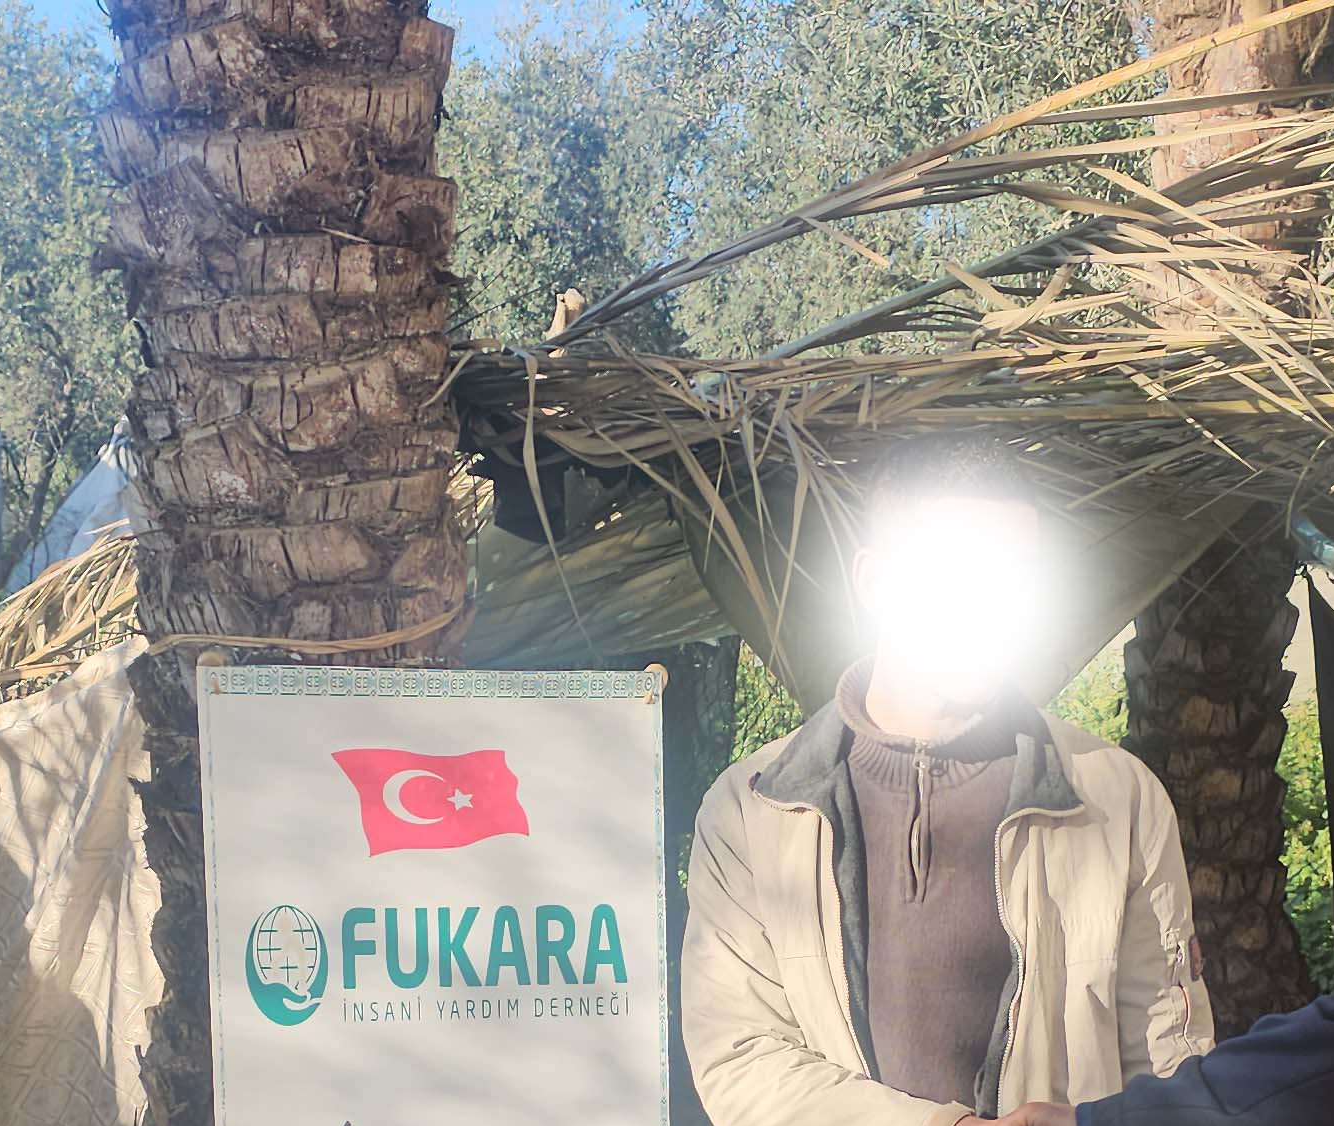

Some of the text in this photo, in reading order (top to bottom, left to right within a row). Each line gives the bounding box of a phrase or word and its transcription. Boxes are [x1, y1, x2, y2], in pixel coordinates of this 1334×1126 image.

[342, 903, 628, 989] FUKARA
[343, 991, 630, 1023] İNSANİ YARDIM DERNEĞİ
